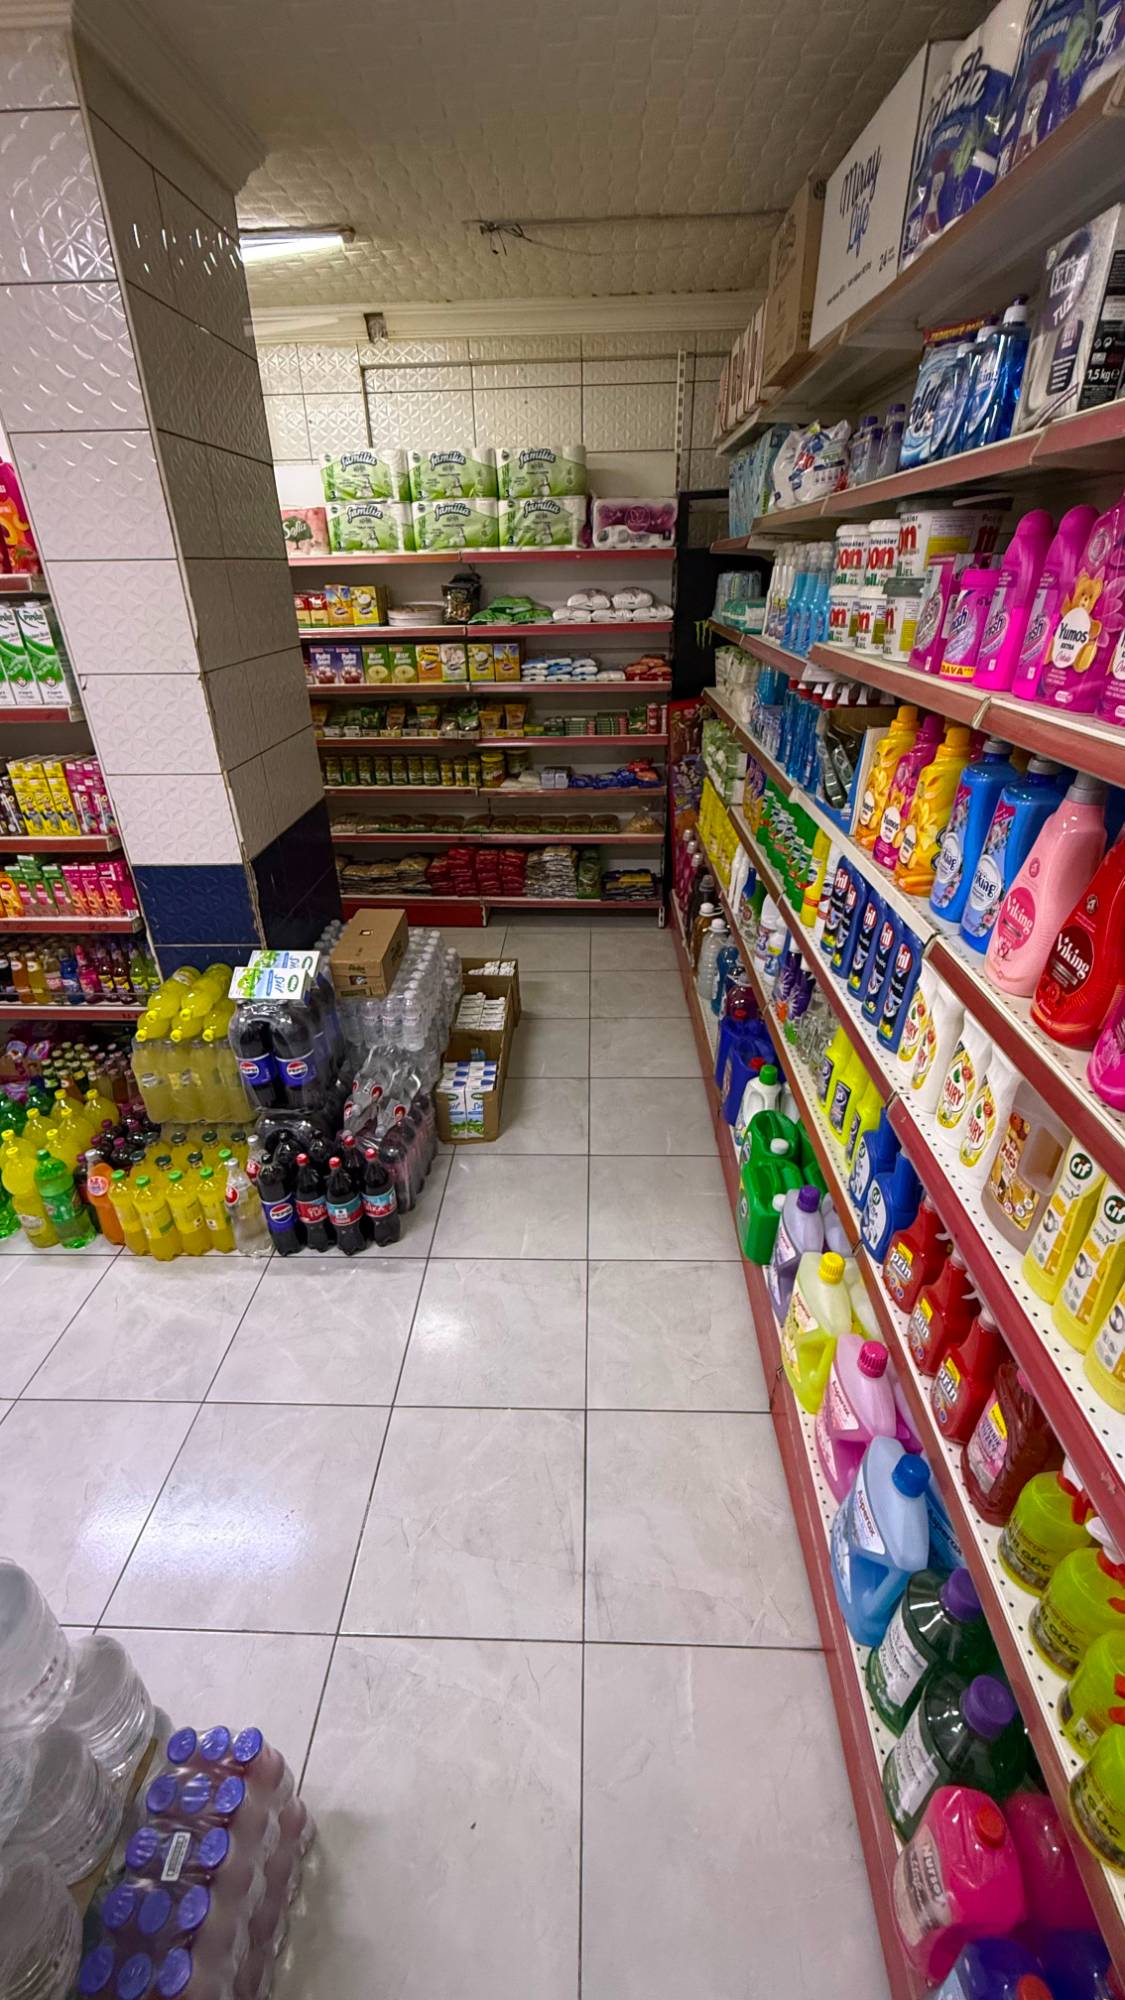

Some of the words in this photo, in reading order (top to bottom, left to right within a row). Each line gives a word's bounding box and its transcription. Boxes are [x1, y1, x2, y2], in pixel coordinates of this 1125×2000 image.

[1100, 367, 1112, 383] kg
[341, 451, 377, 472] familia
[430, 451, 466, 471] familia
[518, 448, 557, 469] familia
[347, 504, 383, 523] familia
[435, 502, 471, 522] familia
[524, 500, 560, 518] familia
[1007, 895, 1033, 935] Viking
[1057, 933, 1090, 980] Viking
[1070, 1156, 1092, 1178] Cif
